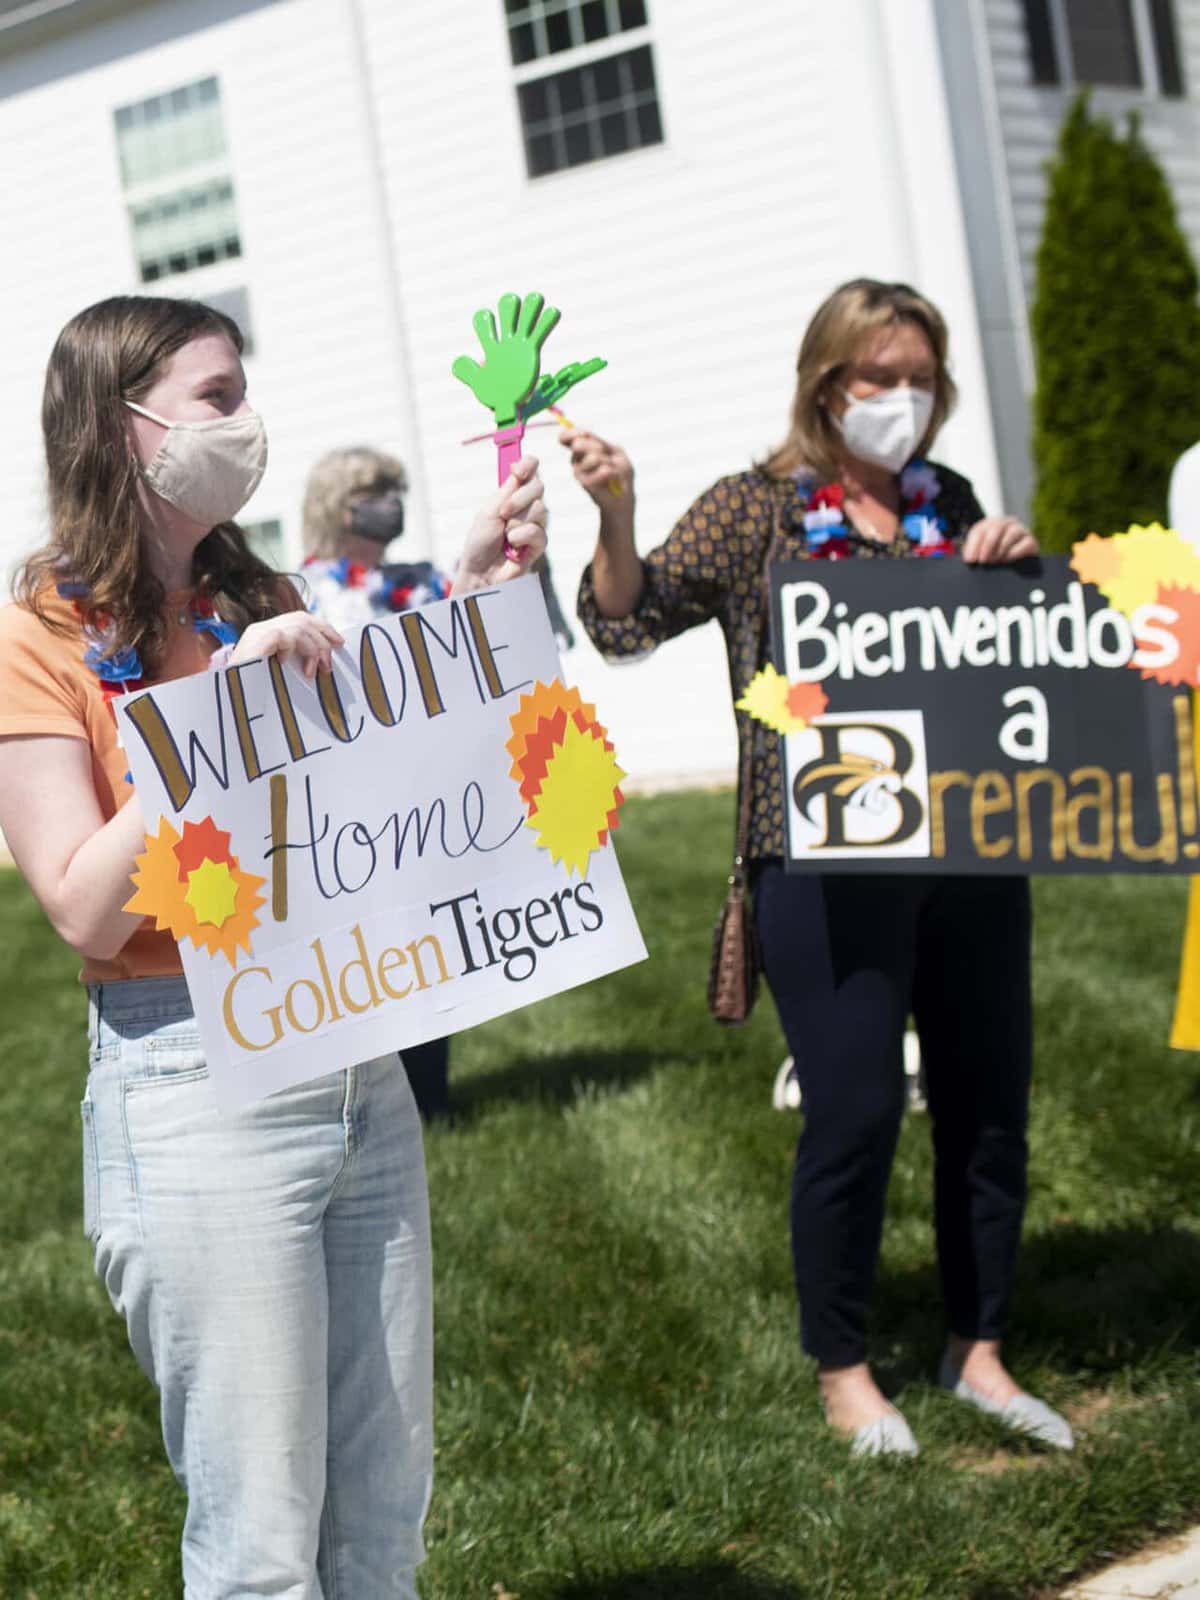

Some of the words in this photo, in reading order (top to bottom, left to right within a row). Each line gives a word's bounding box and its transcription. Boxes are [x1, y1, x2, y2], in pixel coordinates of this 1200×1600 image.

[780, 581, 1180, 682] Bienvenidos
[125, 590, 534, 812] WELCOME
[999, 685, 1049, 763] a
[264, 773, 524, 922] Home
